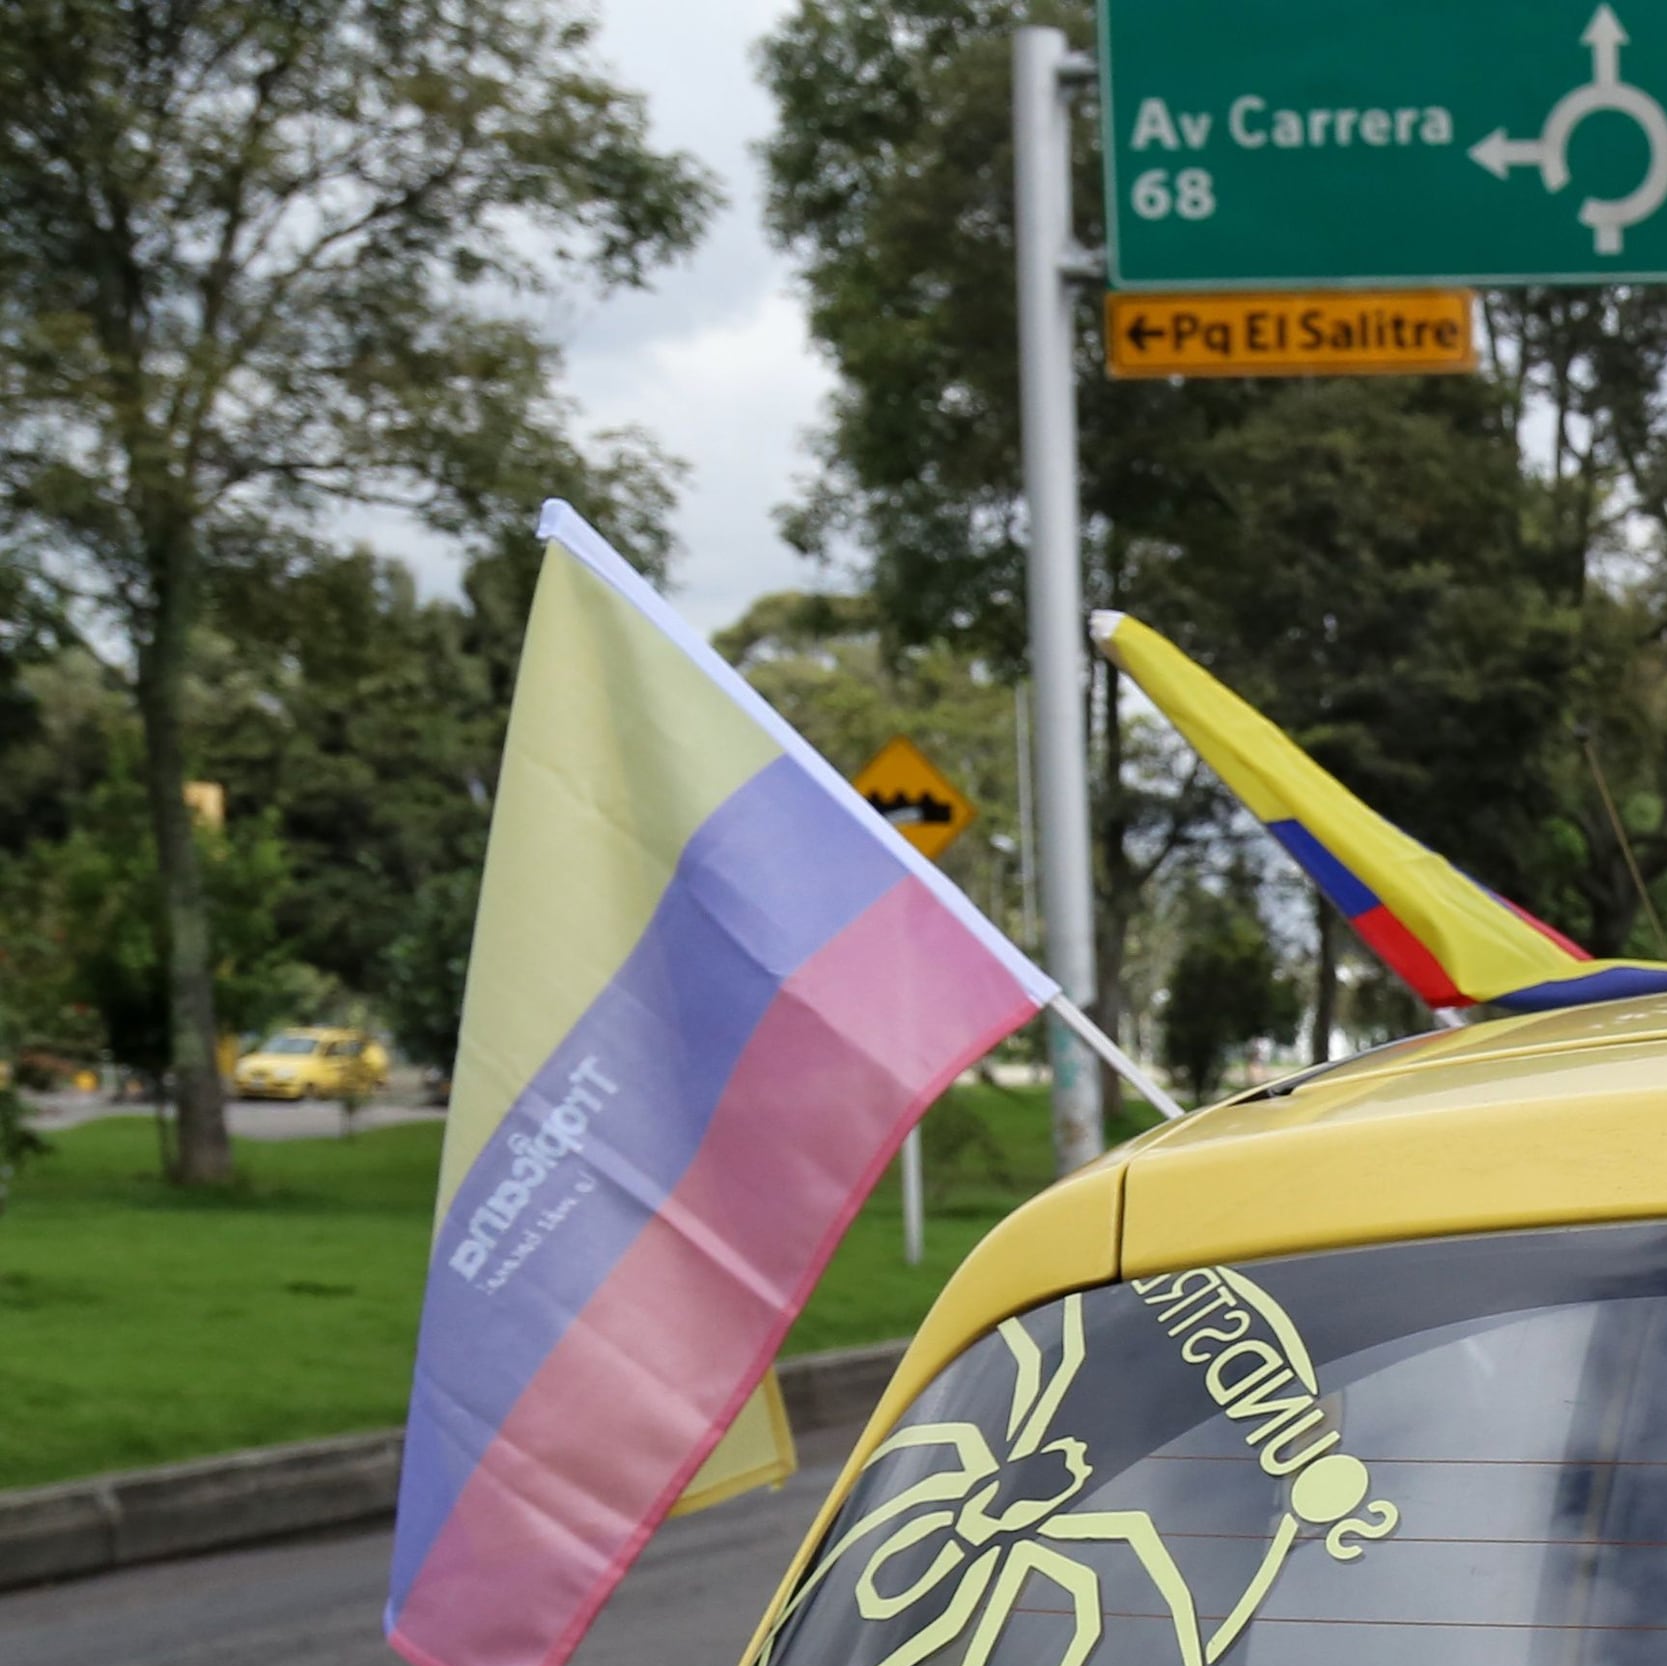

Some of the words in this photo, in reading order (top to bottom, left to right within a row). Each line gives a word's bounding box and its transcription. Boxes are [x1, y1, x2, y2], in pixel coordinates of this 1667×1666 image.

[1130, 97, 1212, 150] Av
[1228, 94, 1453, 149] Carrera
[1130, 168, 1216, 221] 68
[1171, 311, 1240, 356] Pq
[1249, 309, 1288, 351] El
[1298, 307, 1461, 351] Salitre
